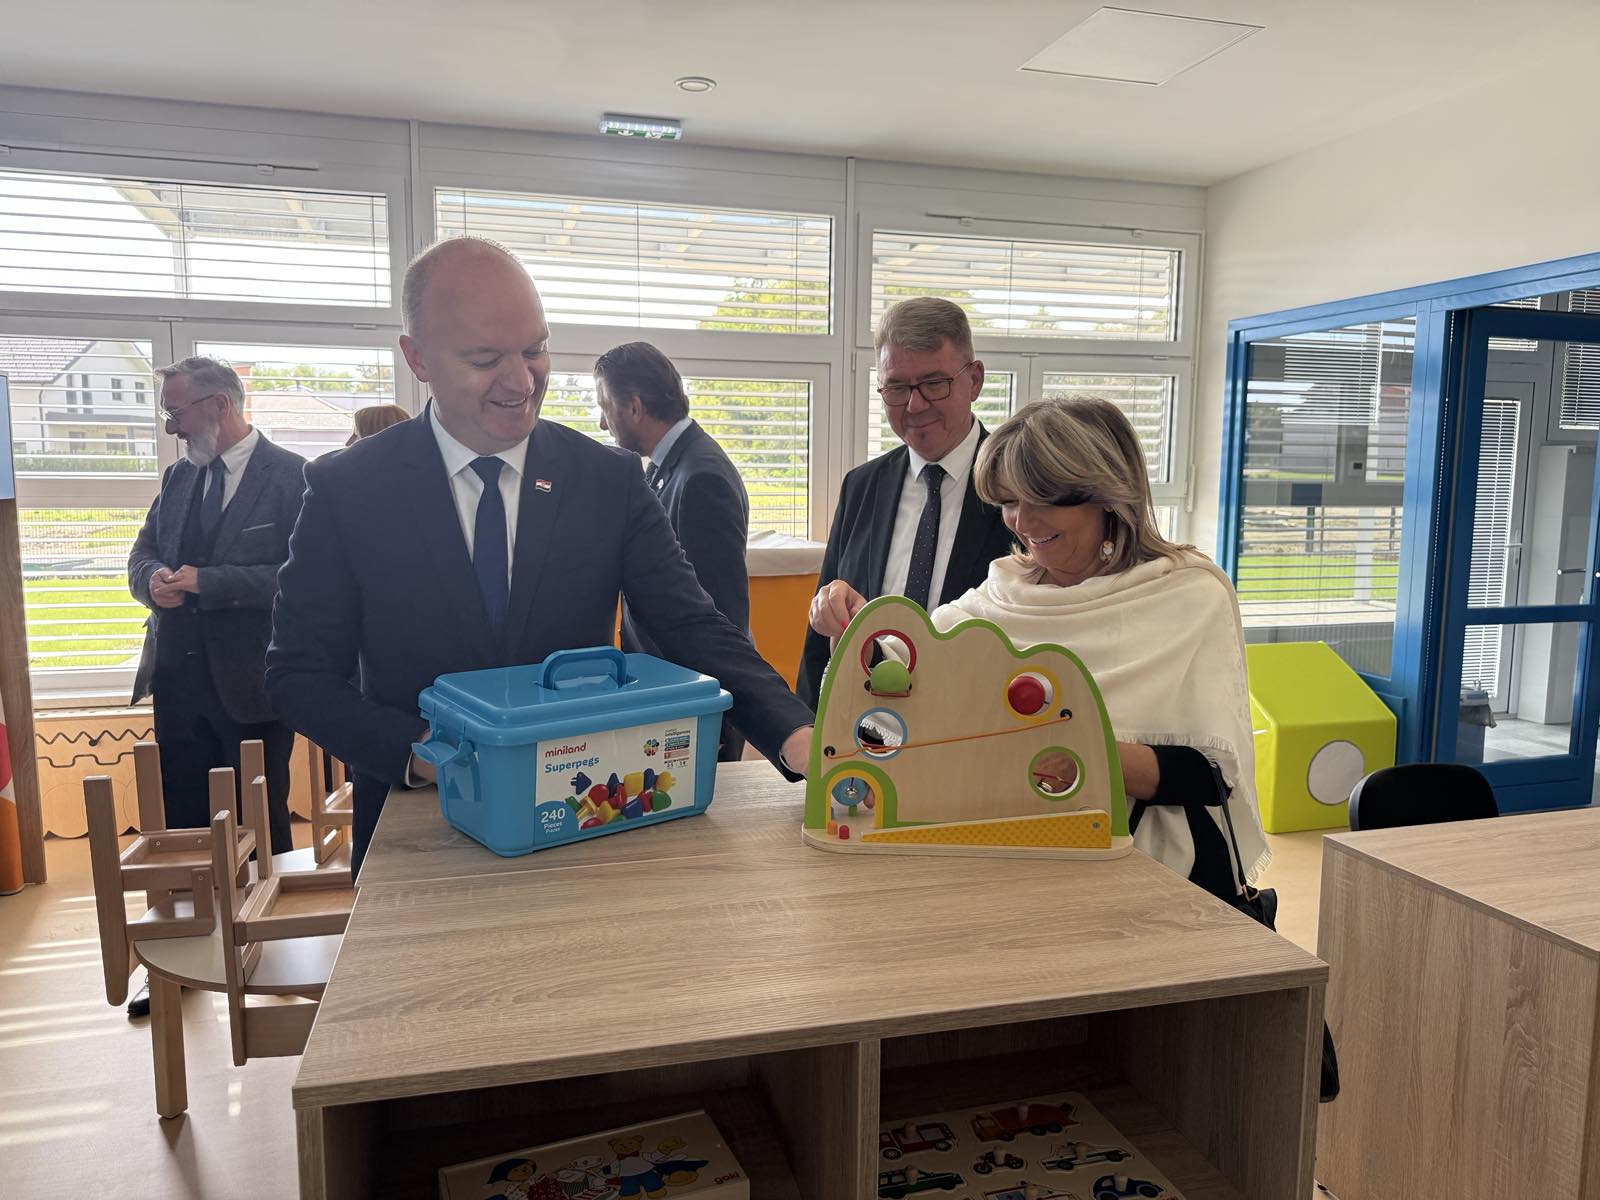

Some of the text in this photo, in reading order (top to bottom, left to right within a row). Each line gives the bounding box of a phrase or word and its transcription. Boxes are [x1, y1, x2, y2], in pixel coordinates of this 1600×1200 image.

[545, 742, 587, 757] miniland
[545, 757, 600, 773] Superpegs
[541, 808, 566, 823] 240
